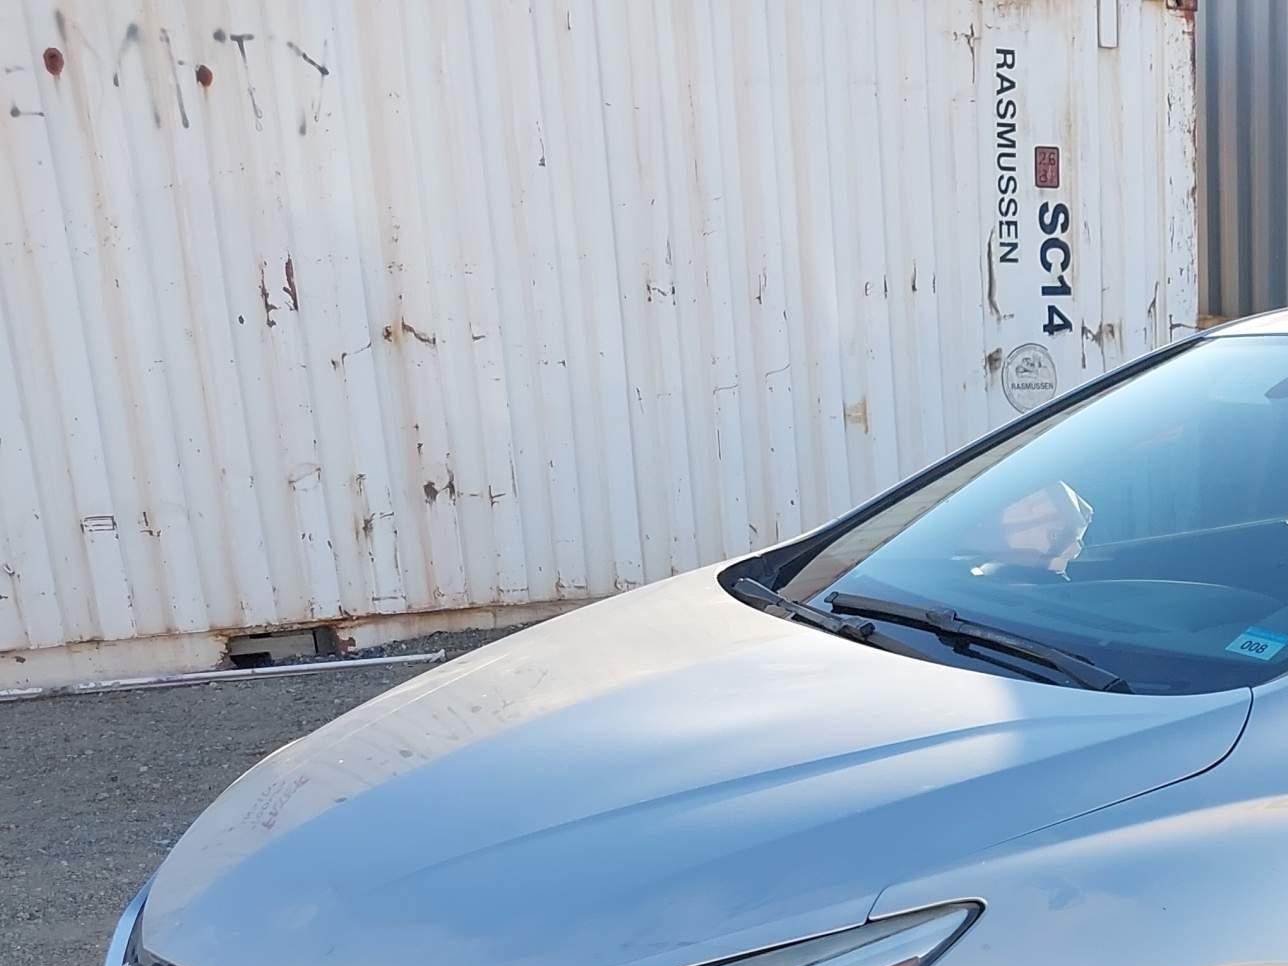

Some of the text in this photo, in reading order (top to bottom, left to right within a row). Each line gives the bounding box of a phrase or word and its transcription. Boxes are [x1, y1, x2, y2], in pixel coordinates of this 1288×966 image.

[995, 48, 1020, 263] RASMUSSEN
[1038, 201, 1073, 336] SC14
[1010, 382, 1054, 391] RASMUSSEN
[1239, 640, 1269, 654] 008
